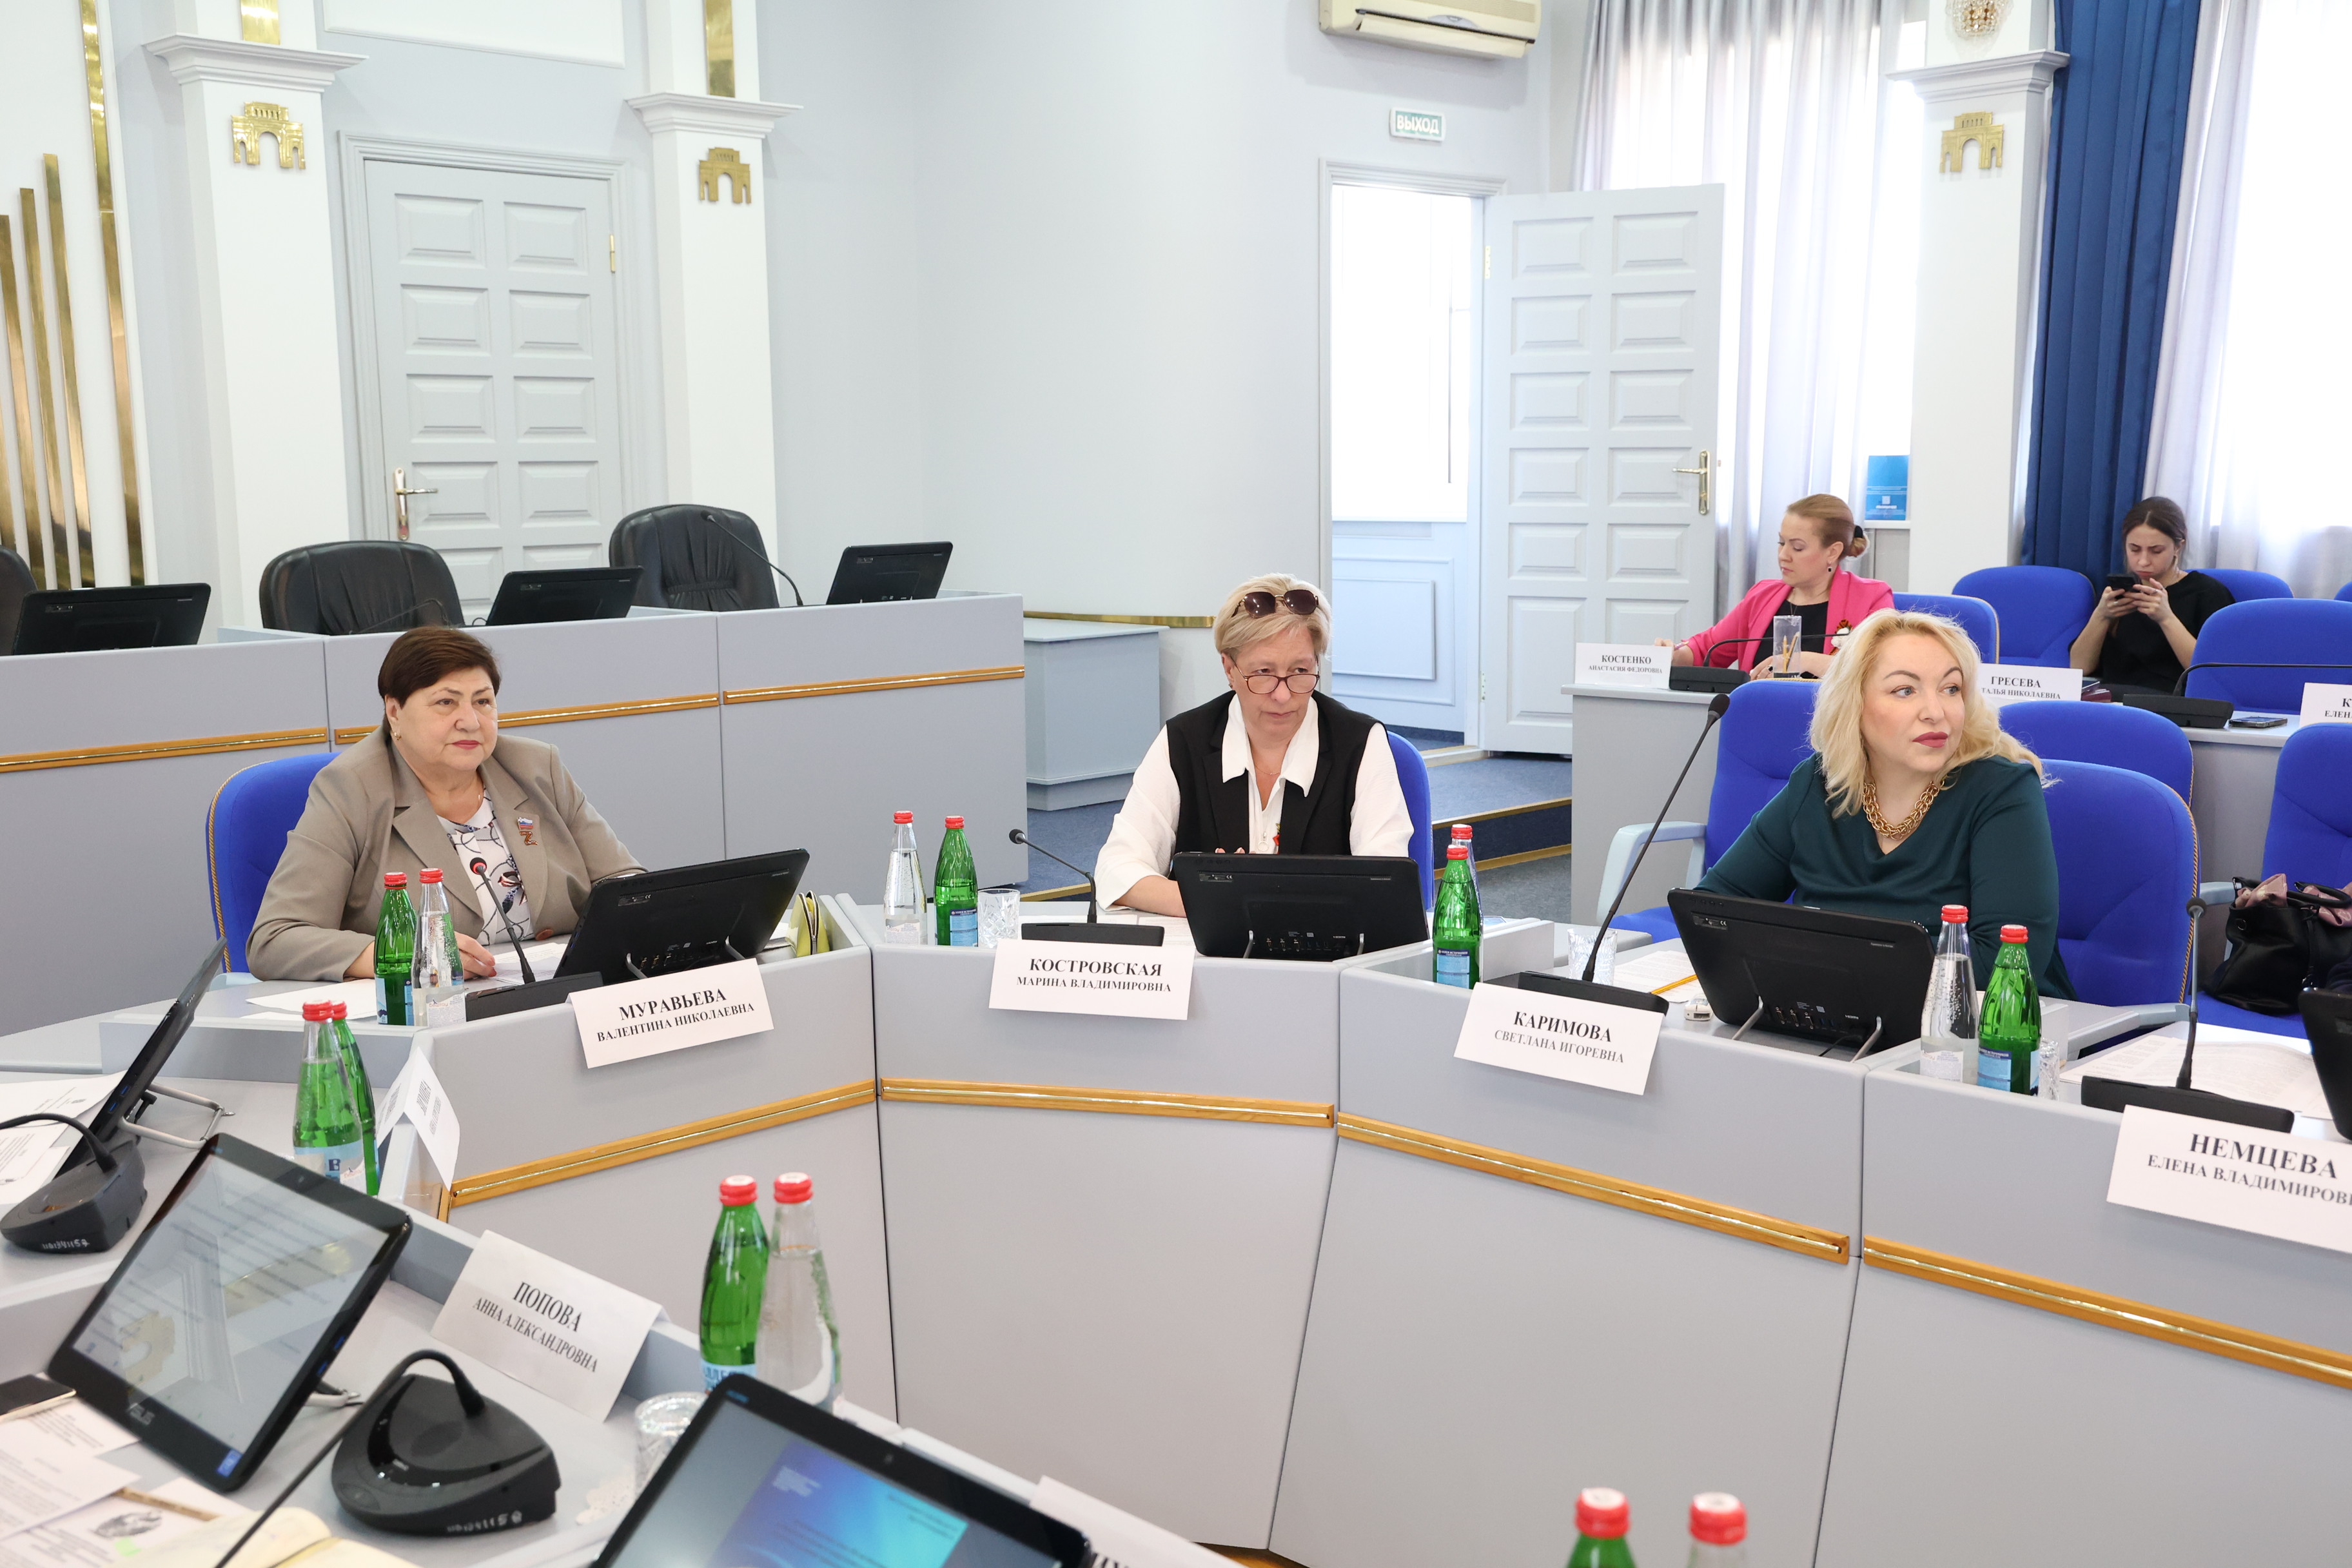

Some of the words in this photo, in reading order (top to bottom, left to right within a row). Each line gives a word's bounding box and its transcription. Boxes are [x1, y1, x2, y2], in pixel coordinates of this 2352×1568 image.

[1396, 114, 1440, 135] ВЫХОД
[1602, 654, 1652, 664] КОСТЕНКО
[1991, 676, 2041, 688] ГРЕСЕВА
[2008, 689, 2061, 700] НИКОЛАЕВНА
[2324, 710, 2352, 718] ЕЛЕН
[1030, 958, 1162, 976] КОСТРОВСКАЯ
[1017, 976, 1066, 987] МАРИНА
[1070, 979, 1171, 992] ВЛАДИМИРОВНА
[619, 988, 727, 1021] МУРАВЬЕВА
[597, 1019, 672, 1042] ВАЛЕНТИНА
[674, 1003, 754, 1026] НИКОЛАЕВНА
[1514, 1011, 1611, 1043] КАРИМОВА
[1494, 1030, 1556, 1050] СВЕТЛАНА
[1560, 1041, 1623, 1063] ИГОРЕВНА
[2190, 1133, 2337, 1179] НЕМЦЕВА
[2148, 1154, 2207, 1177] ЕЛЕНА
[2213, 1167, 2352, 1206] ВЛАДИМИРОВ
[513, 1282, 582, 1332] ПОПОВА
[473, 1297, 503, 1322] АННА
[503, 1313, 598, 1373] АЛЕКСАНДРОВНА
